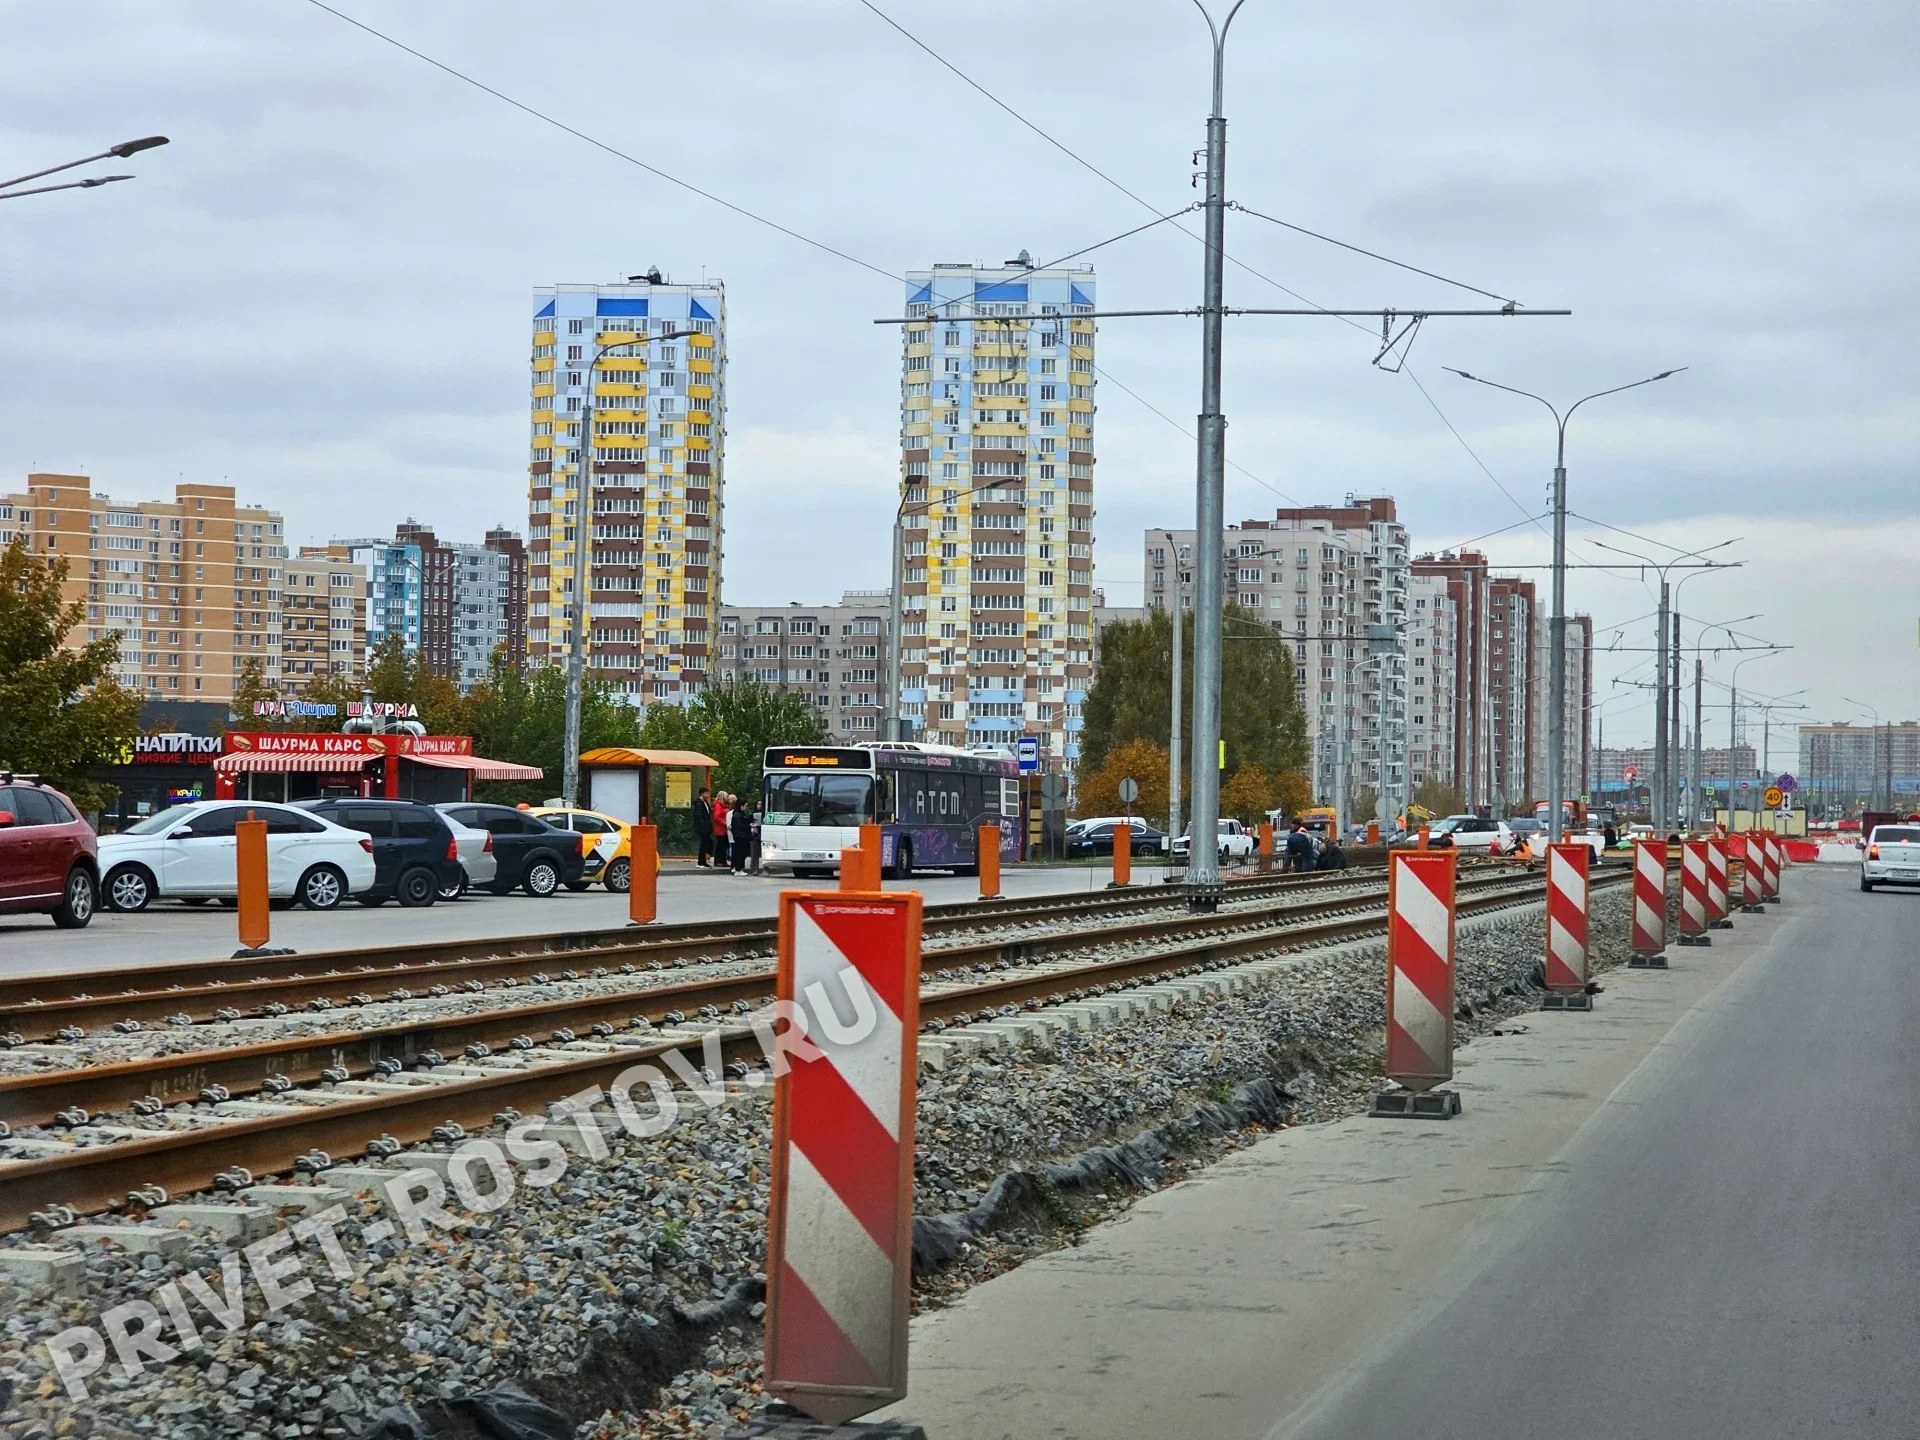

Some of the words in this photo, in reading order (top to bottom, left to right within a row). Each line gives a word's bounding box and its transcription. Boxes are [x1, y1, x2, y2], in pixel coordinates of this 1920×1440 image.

[253, 701, 286, 716] ШАУРМА
[346, 702, 418, 717] ШАУРМА
[135, 736, 222, 753] НАПИТКИ
[258, 737, 319, 751] ШАУРМА
[324, 738, 363, 752] КАРС
[413, 740, 439, 753] ШАУРМА
[440, 741, 456, 753] КАРС
[136, 753, 182, 764] НИЗКИЕ
[169, 789, 202, 798] ОТКРЫТО
[1767, 793, 1780, 801] 40
